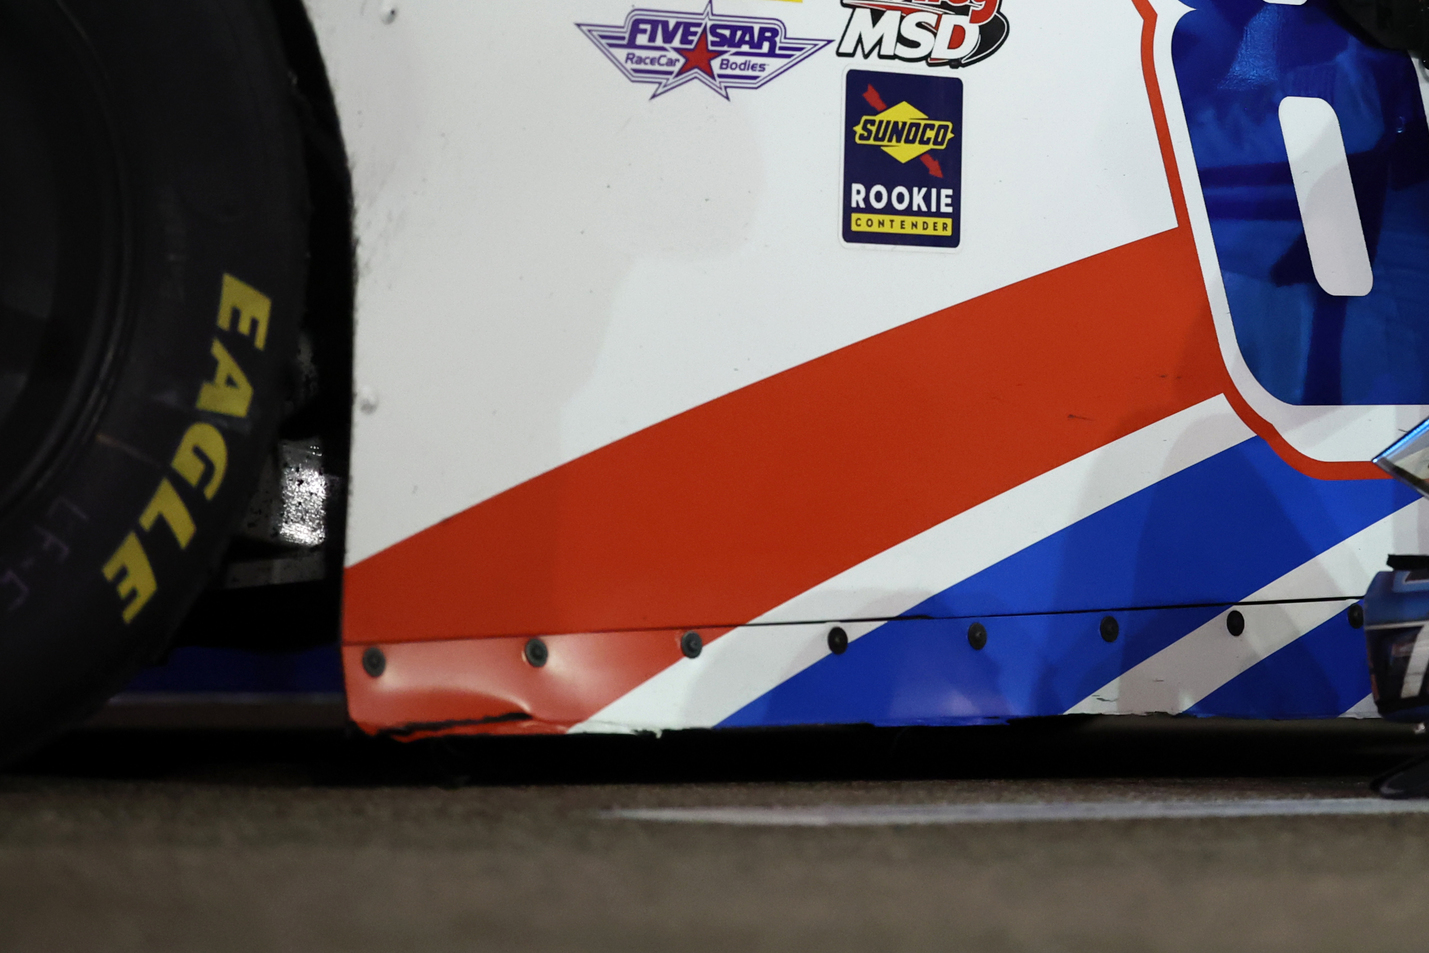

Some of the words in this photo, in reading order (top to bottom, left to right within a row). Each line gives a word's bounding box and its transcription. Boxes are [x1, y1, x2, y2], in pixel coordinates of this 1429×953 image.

[626, 17, 702, 48] FIVE
[707, 26, 783, 51] STAR
[837, 8, 983, 62] MSD
[718, 58, 767, 74] Bodies
[859, 118, 952, 148] SUNOCO
[850, 182, 954, 214] ROOKIE
[853, 216, 950, 233] CONTENDER
[102, 273, 272, 624] EAGLE
